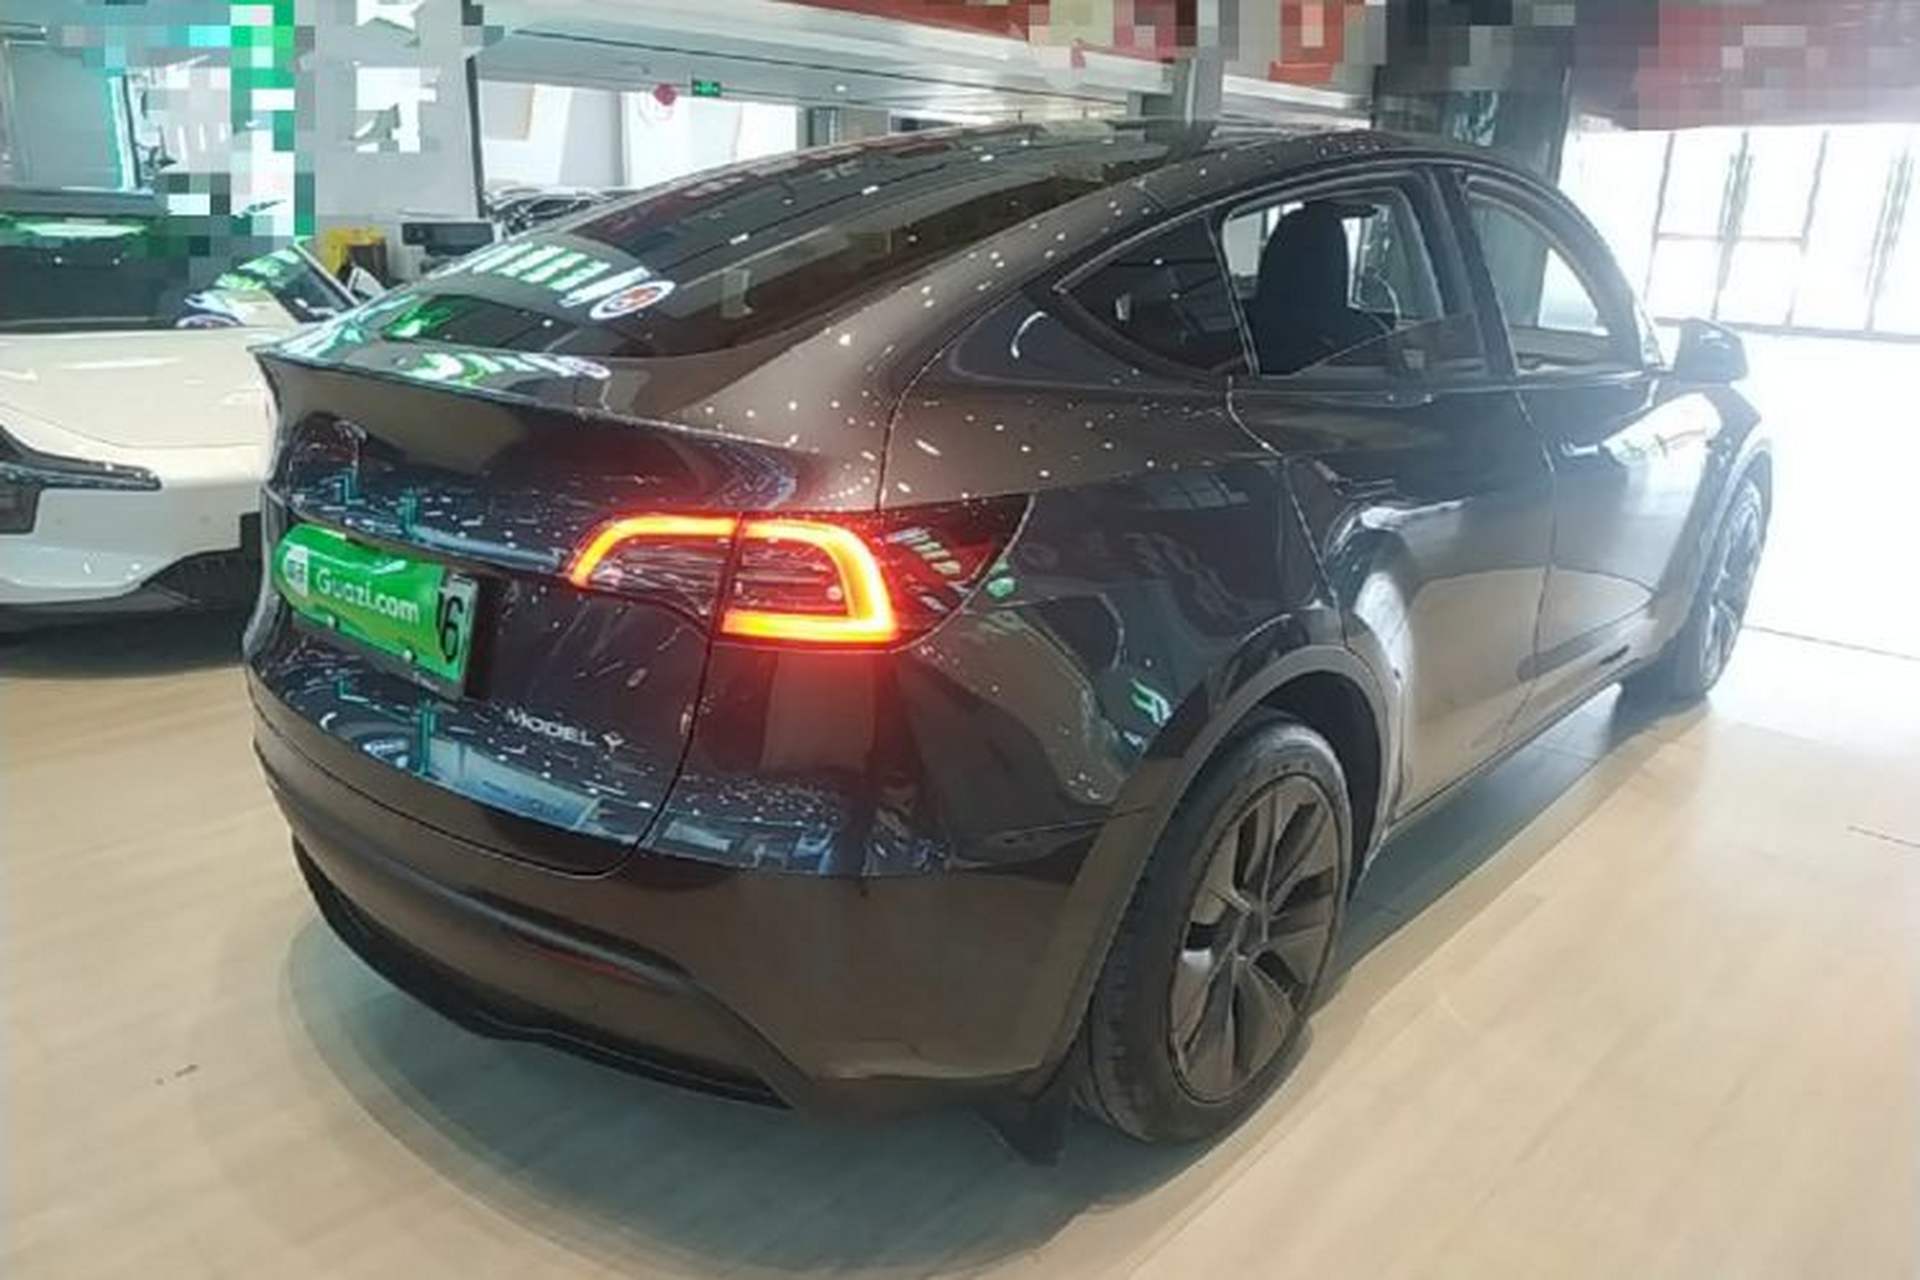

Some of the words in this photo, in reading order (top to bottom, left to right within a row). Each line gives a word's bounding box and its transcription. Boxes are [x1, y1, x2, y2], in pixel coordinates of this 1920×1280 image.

[436, 592, 464, 664] 6
[506, 708, 596, 747] MODEL
[602, 733, 625, 752] Y
